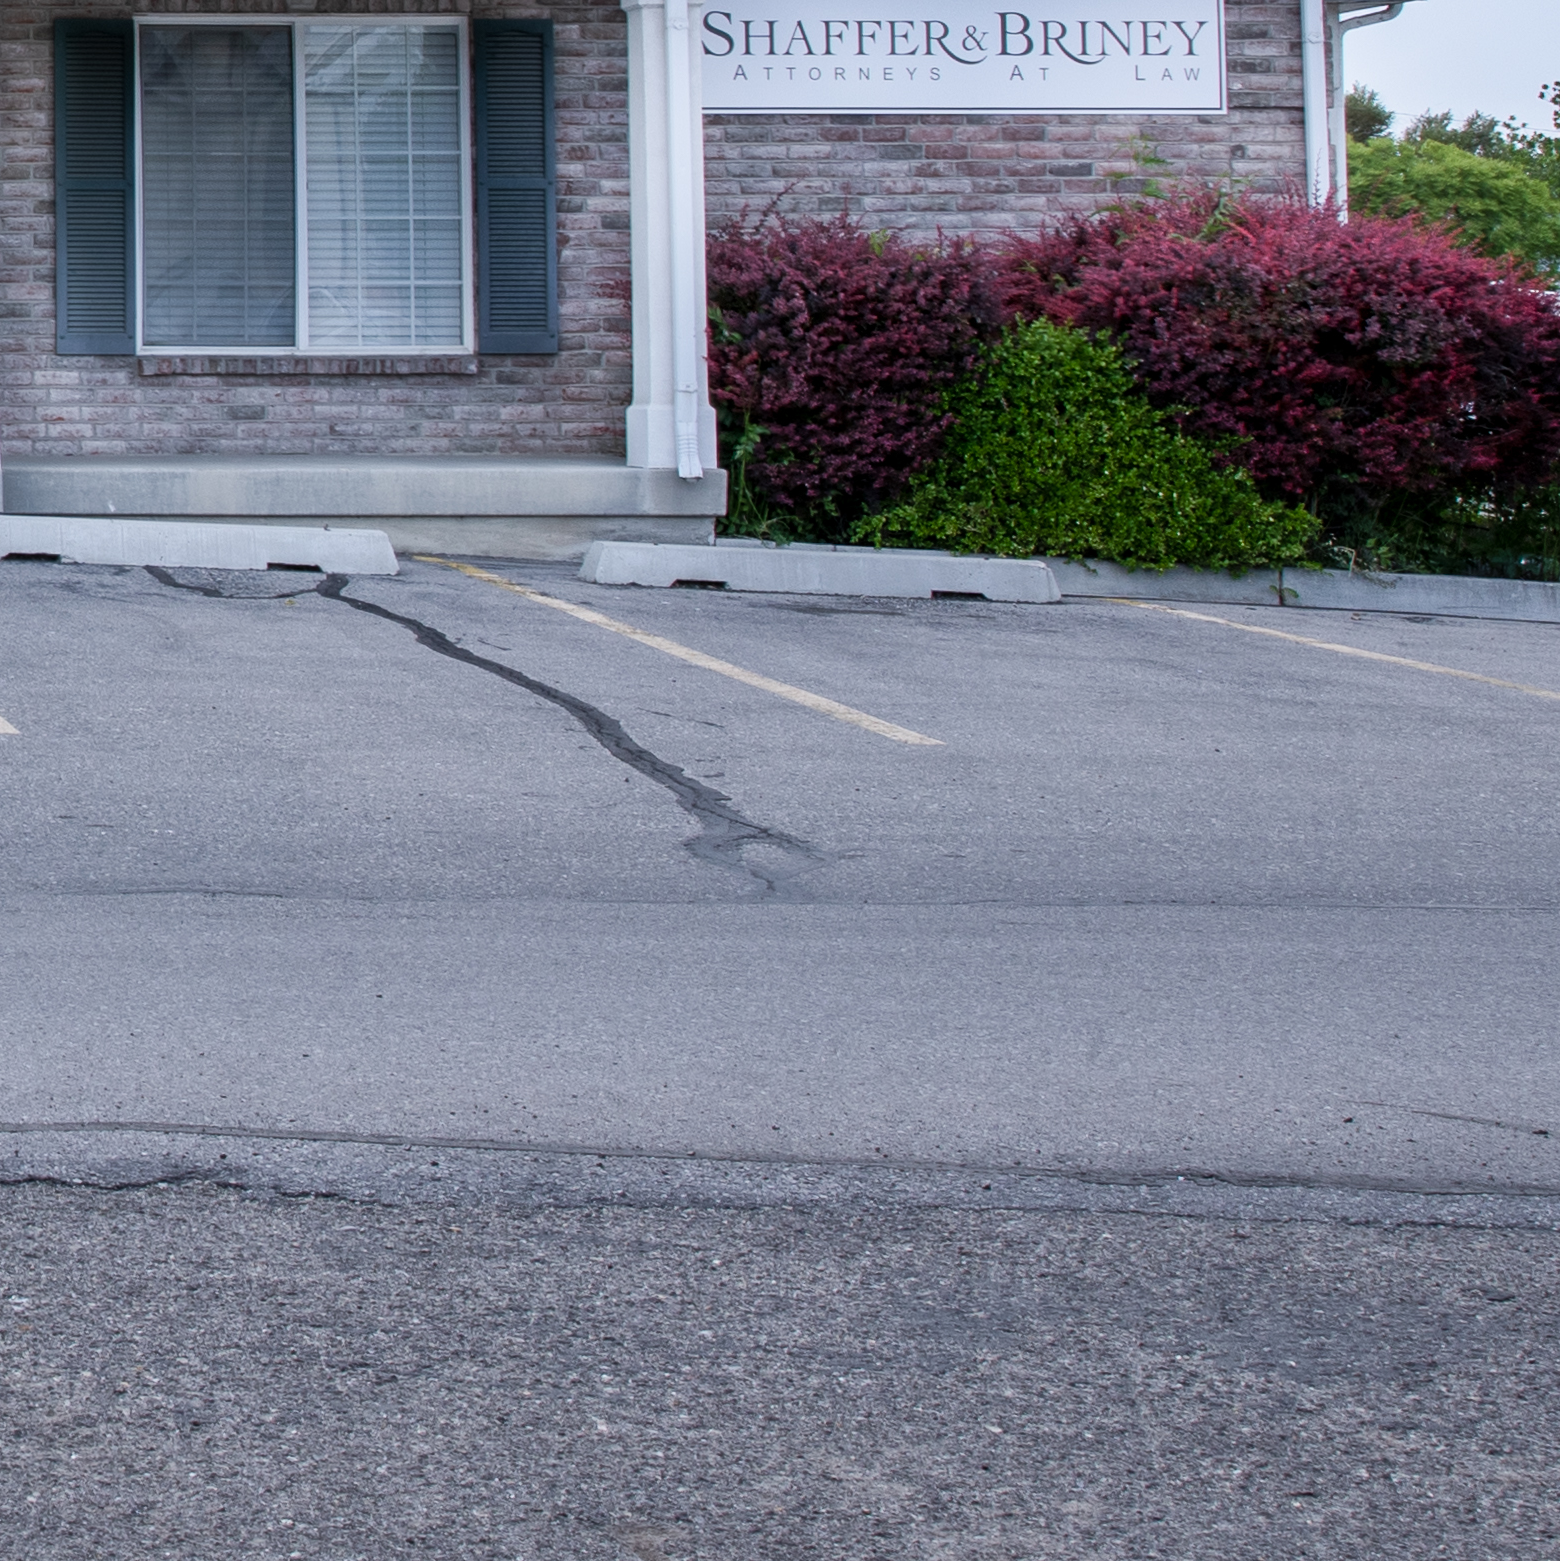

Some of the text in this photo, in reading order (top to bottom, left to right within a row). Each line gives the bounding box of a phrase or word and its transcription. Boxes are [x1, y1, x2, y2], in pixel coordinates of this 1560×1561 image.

[702, 10, 1209, 65] SHAFFER & BRINEY
[733, 65, 1200, 81] ATTORNEYS AT LAW
